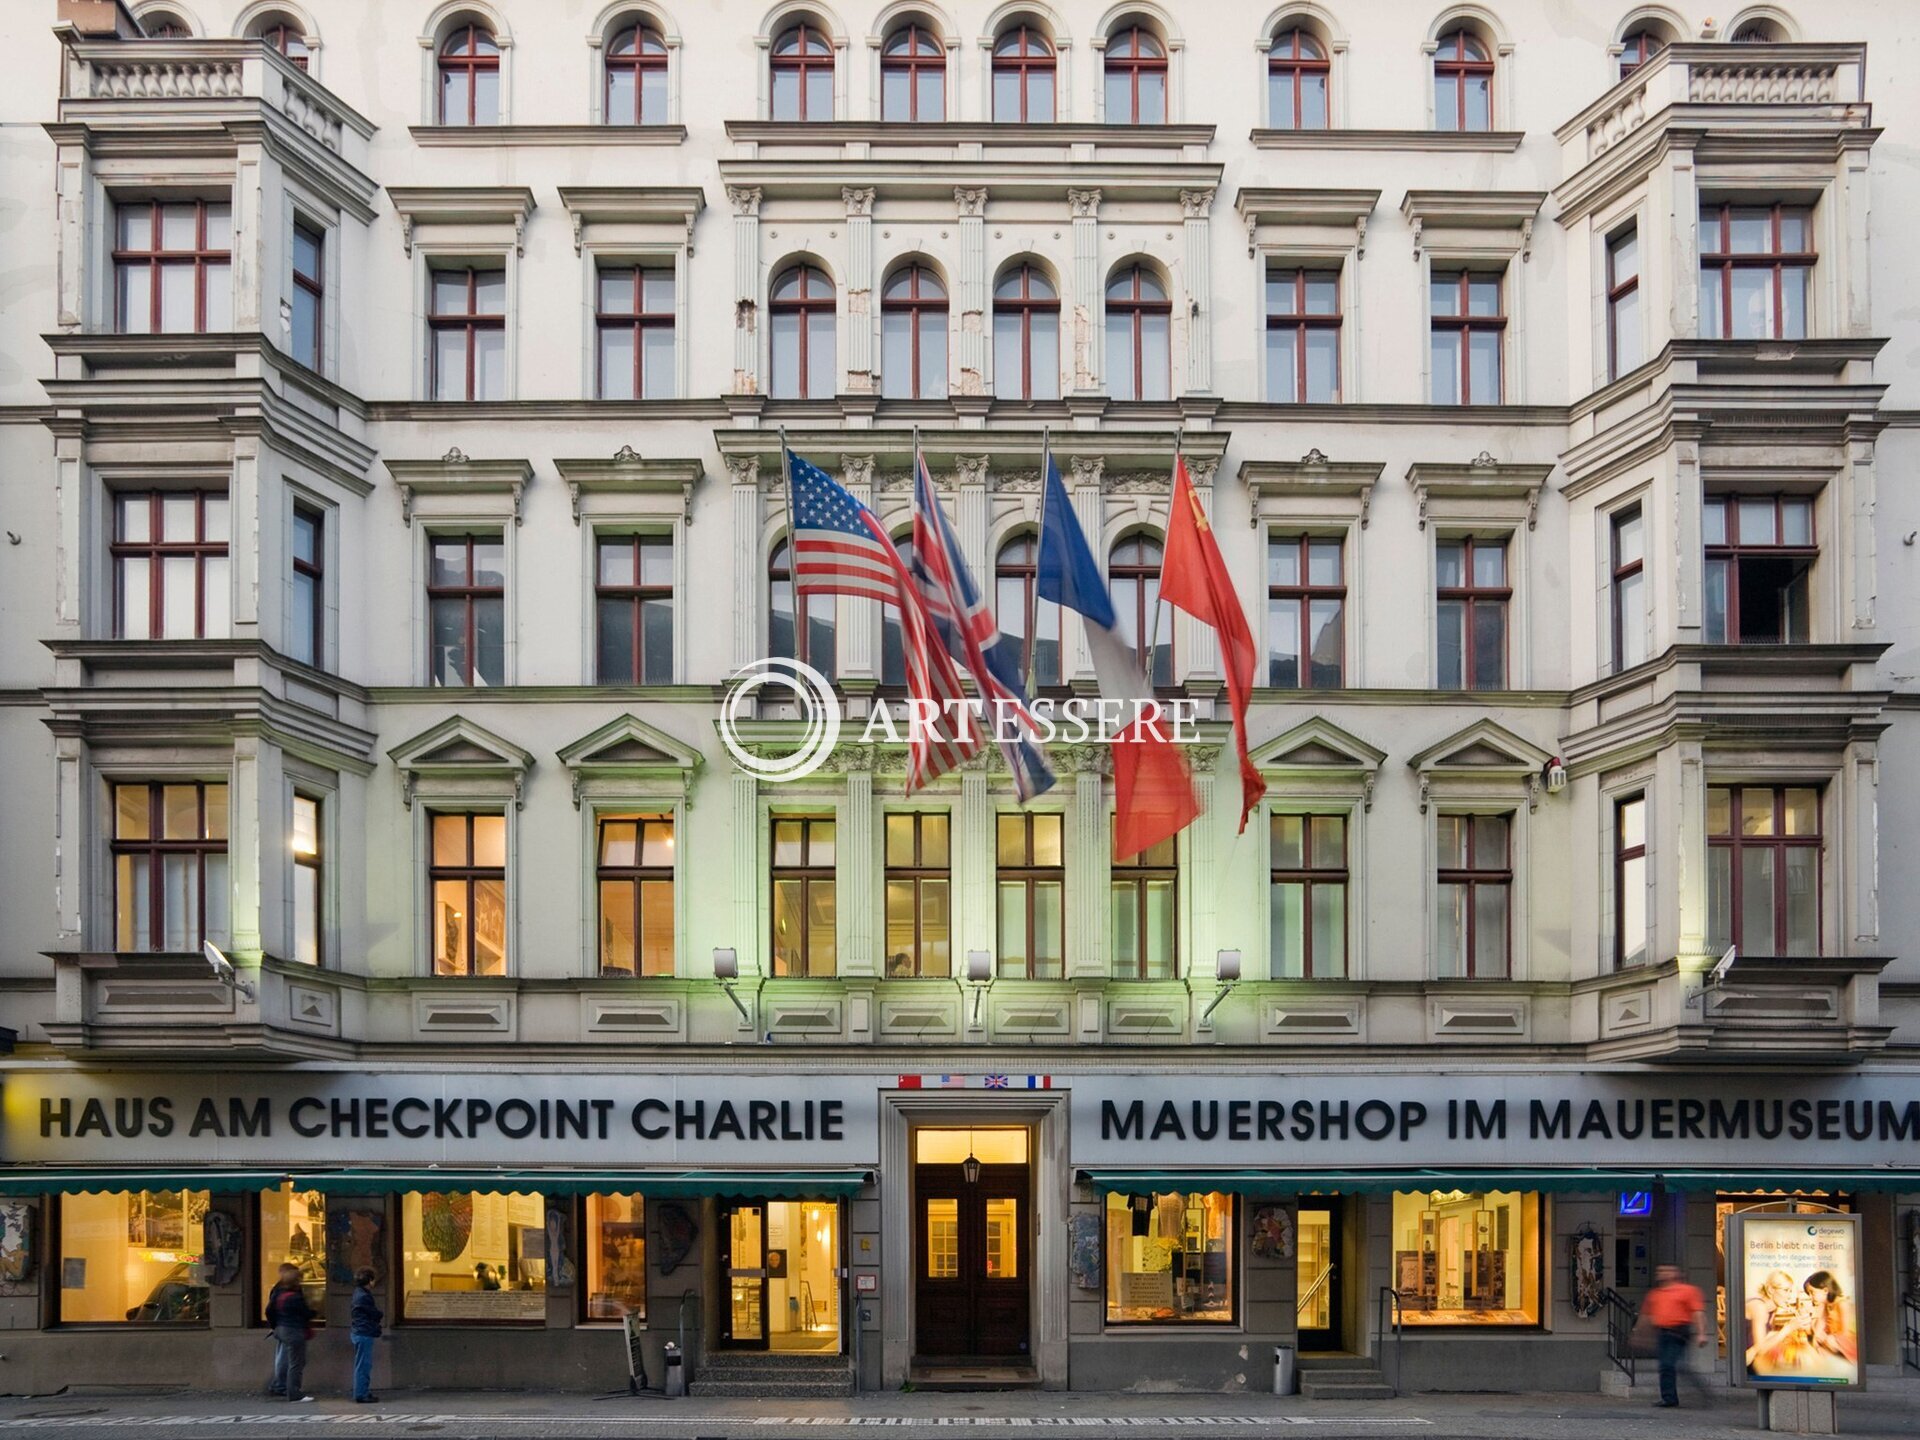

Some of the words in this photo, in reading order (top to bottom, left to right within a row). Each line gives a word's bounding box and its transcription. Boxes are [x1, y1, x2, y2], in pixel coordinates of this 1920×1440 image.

[40, 1097, 174, 1138] HAUS
[189, 1098, 271, 1138] AM
[289, 1098, 614, 1139] CHECKPOINT
[632, 1098, 843, 1140] CHARLIE
[1102, 1099, 1427, 1141] MAUERSHOP
[1448, 1100, 1506, 1139] IM
[1530, 1099, 1920, 1141] MAUERMUSEUM
[1819, 1227, 1845, 1235] degewo
[1750, 1241, 1774, 1249] Berlin
[1776, 1241, 1800, 1249] bleibt
